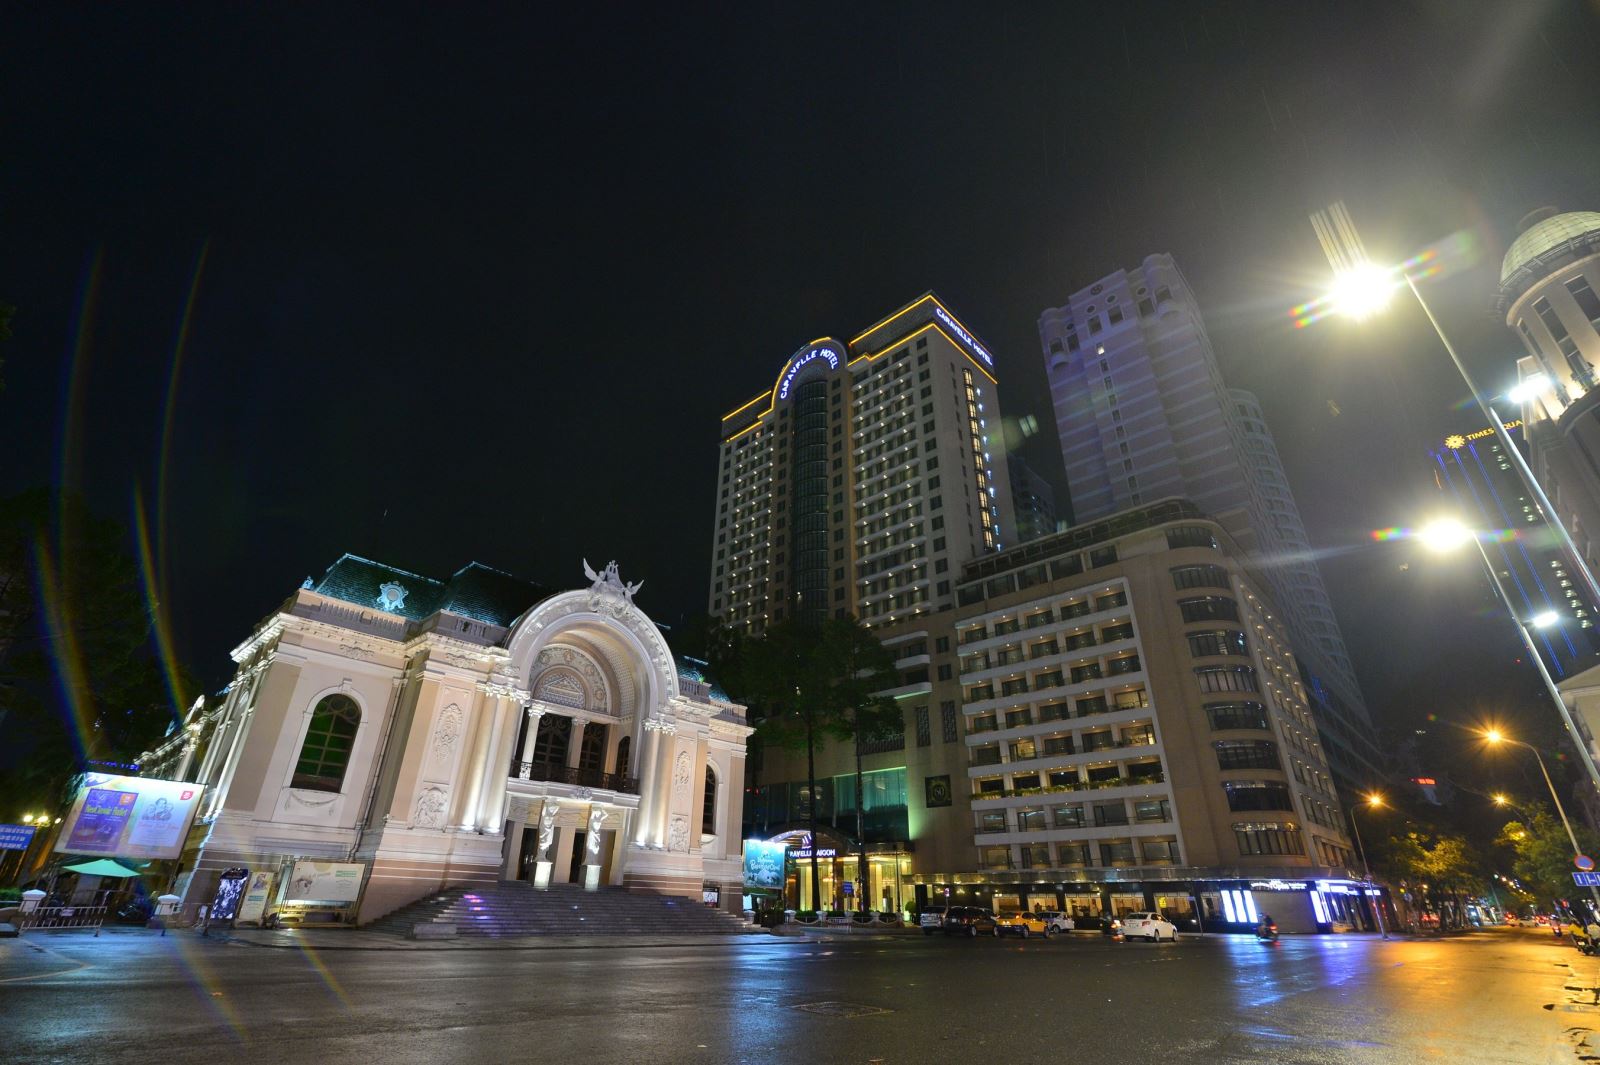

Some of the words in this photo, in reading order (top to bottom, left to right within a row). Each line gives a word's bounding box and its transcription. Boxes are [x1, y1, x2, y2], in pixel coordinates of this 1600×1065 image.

[936, 308, 972, 346] CARAVELLE
[973, 343, 993, 366] HOTEL
[780, 350, 817, 399] CARAVELLE
[820, 349, 838, 370] HOTEL
[1465, 427, 1495, 440] TIMES
